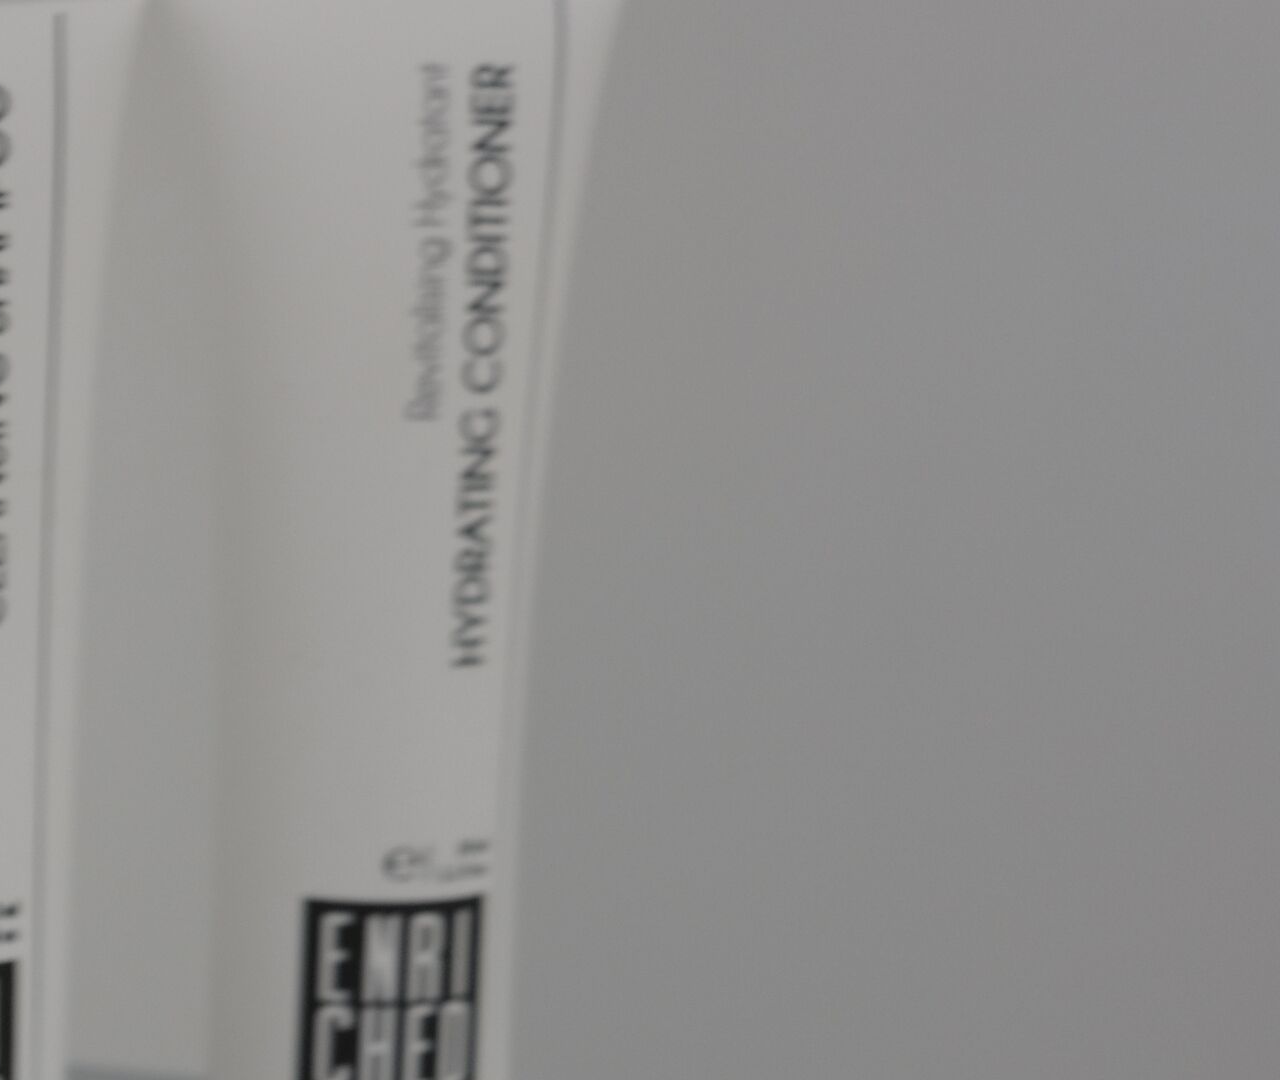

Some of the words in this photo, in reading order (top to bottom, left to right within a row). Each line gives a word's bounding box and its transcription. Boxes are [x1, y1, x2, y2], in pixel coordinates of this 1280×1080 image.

[459, 62, 516, 396] CONDITIONER
[449, 406, 500, 669] HYDRATING
[316, 906, 474, 1002] ENRI
